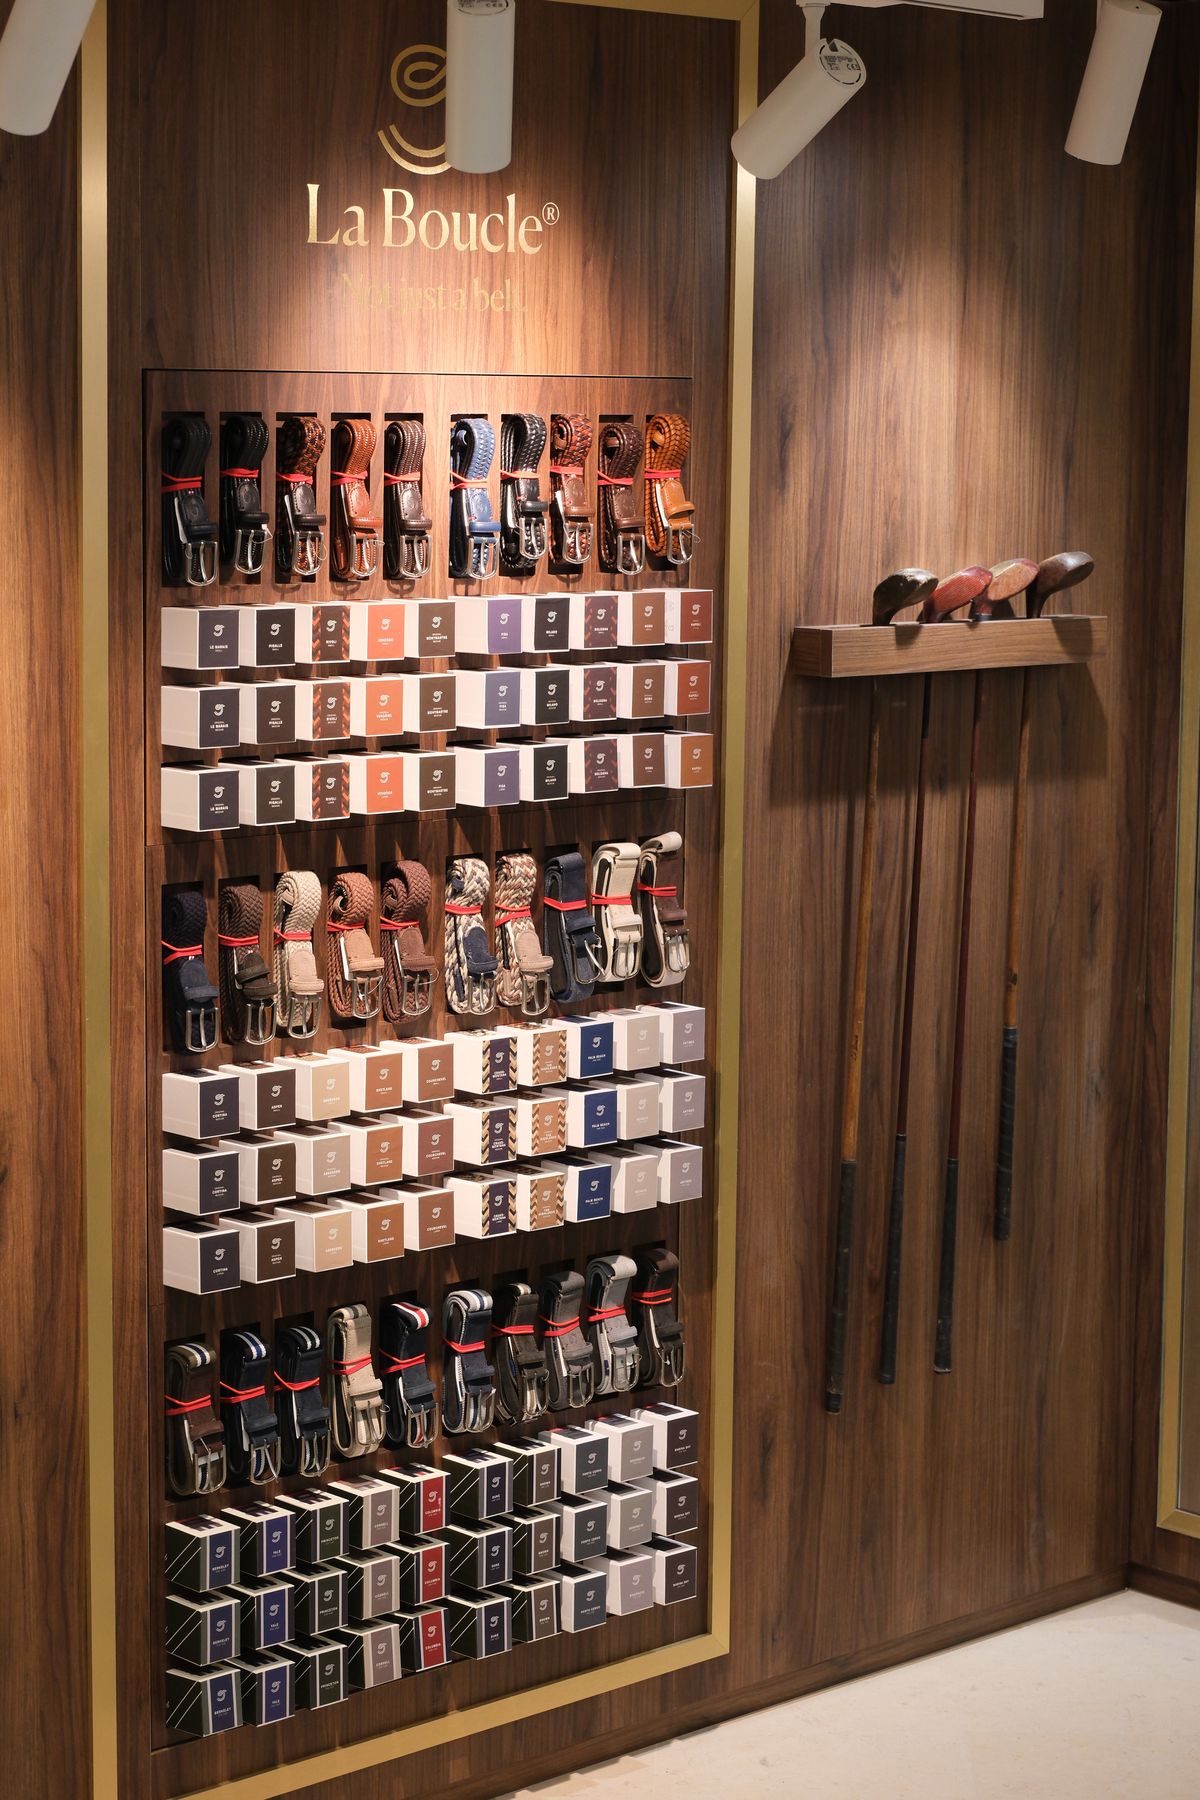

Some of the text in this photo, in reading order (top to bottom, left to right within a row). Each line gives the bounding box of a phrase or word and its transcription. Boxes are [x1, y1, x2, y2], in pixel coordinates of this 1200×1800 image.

[306, 183, 370, 248] La
[342, 274, 528, 315] Not just a belt
